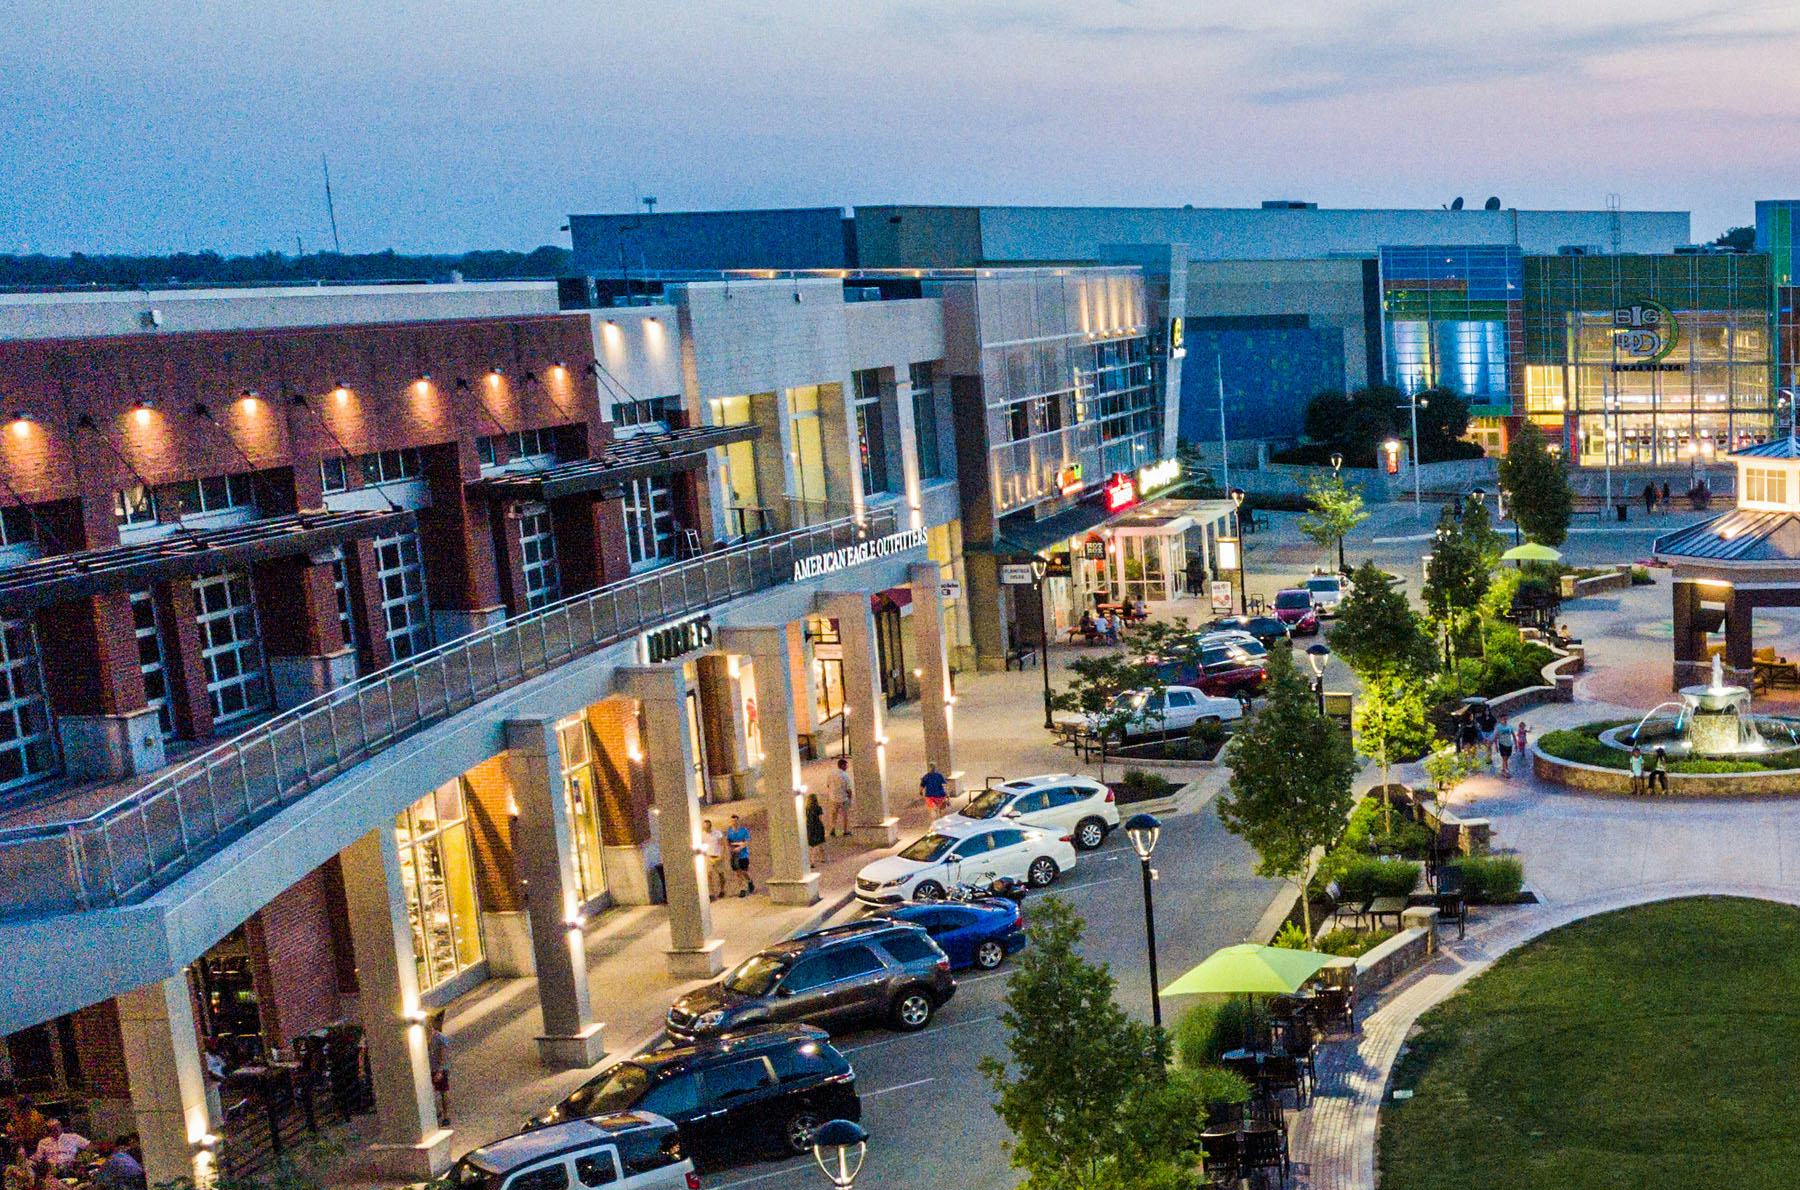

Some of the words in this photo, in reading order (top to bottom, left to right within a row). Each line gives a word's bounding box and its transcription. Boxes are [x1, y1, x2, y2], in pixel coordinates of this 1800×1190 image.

[794, 547, 848, 582] AMERICAN
[847, 540, 876, 566] EAGLE
[877, 526, 928, 558] OUTFITTERS
